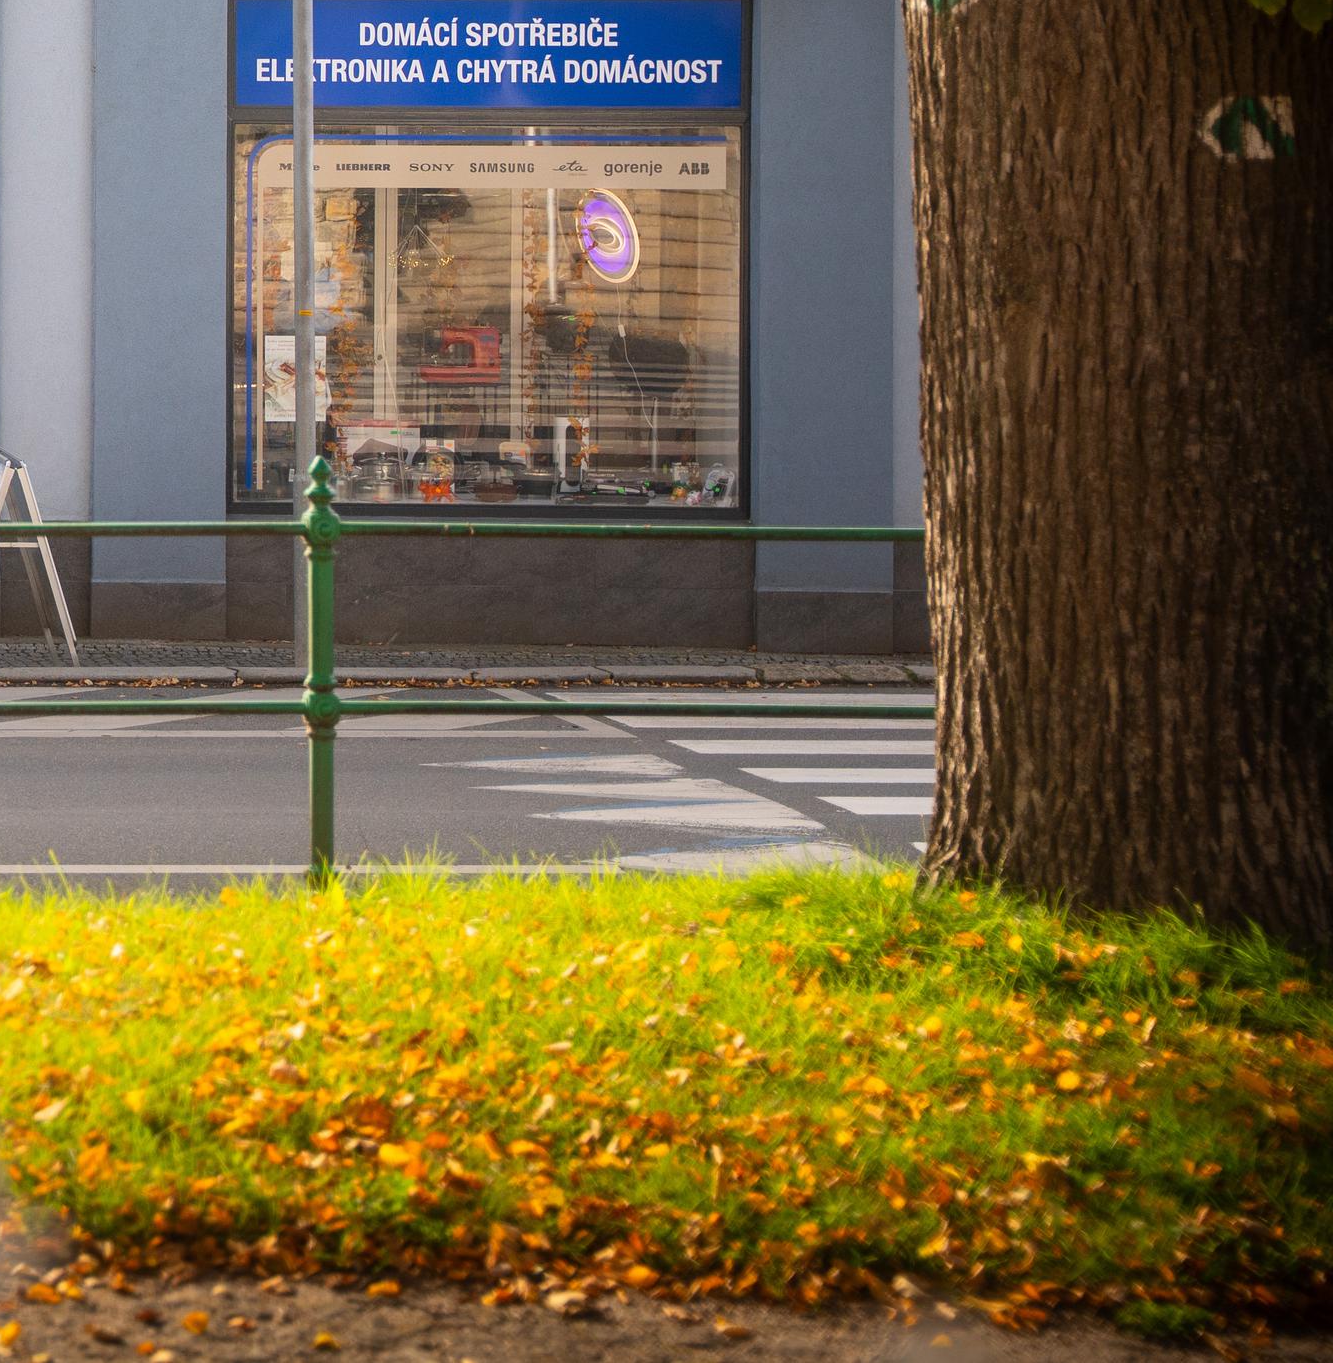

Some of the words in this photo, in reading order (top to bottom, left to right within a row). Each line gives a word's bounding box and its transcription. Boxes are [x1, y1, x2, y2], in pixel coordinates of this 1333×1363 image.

[359, 17, 459, 47] DOMÁCÍ
[465, 17, 618, 47] SPOTŘEBIČE
[431, 59, 450, 83] A
[456, 54, 555, 84] CHYTRÁ
[564, 54, 723, 84] DOMÁCNOST
[336, 163, 391, 172] LIEBHERR
[409, 163, 455, 172] SONY
[469, 162, 535, 174] SAMSUNG
[552, 160, 588, 172] eta
[603, 160, 663, 177] gorenje
[678, 162, 710, 175] ABB
